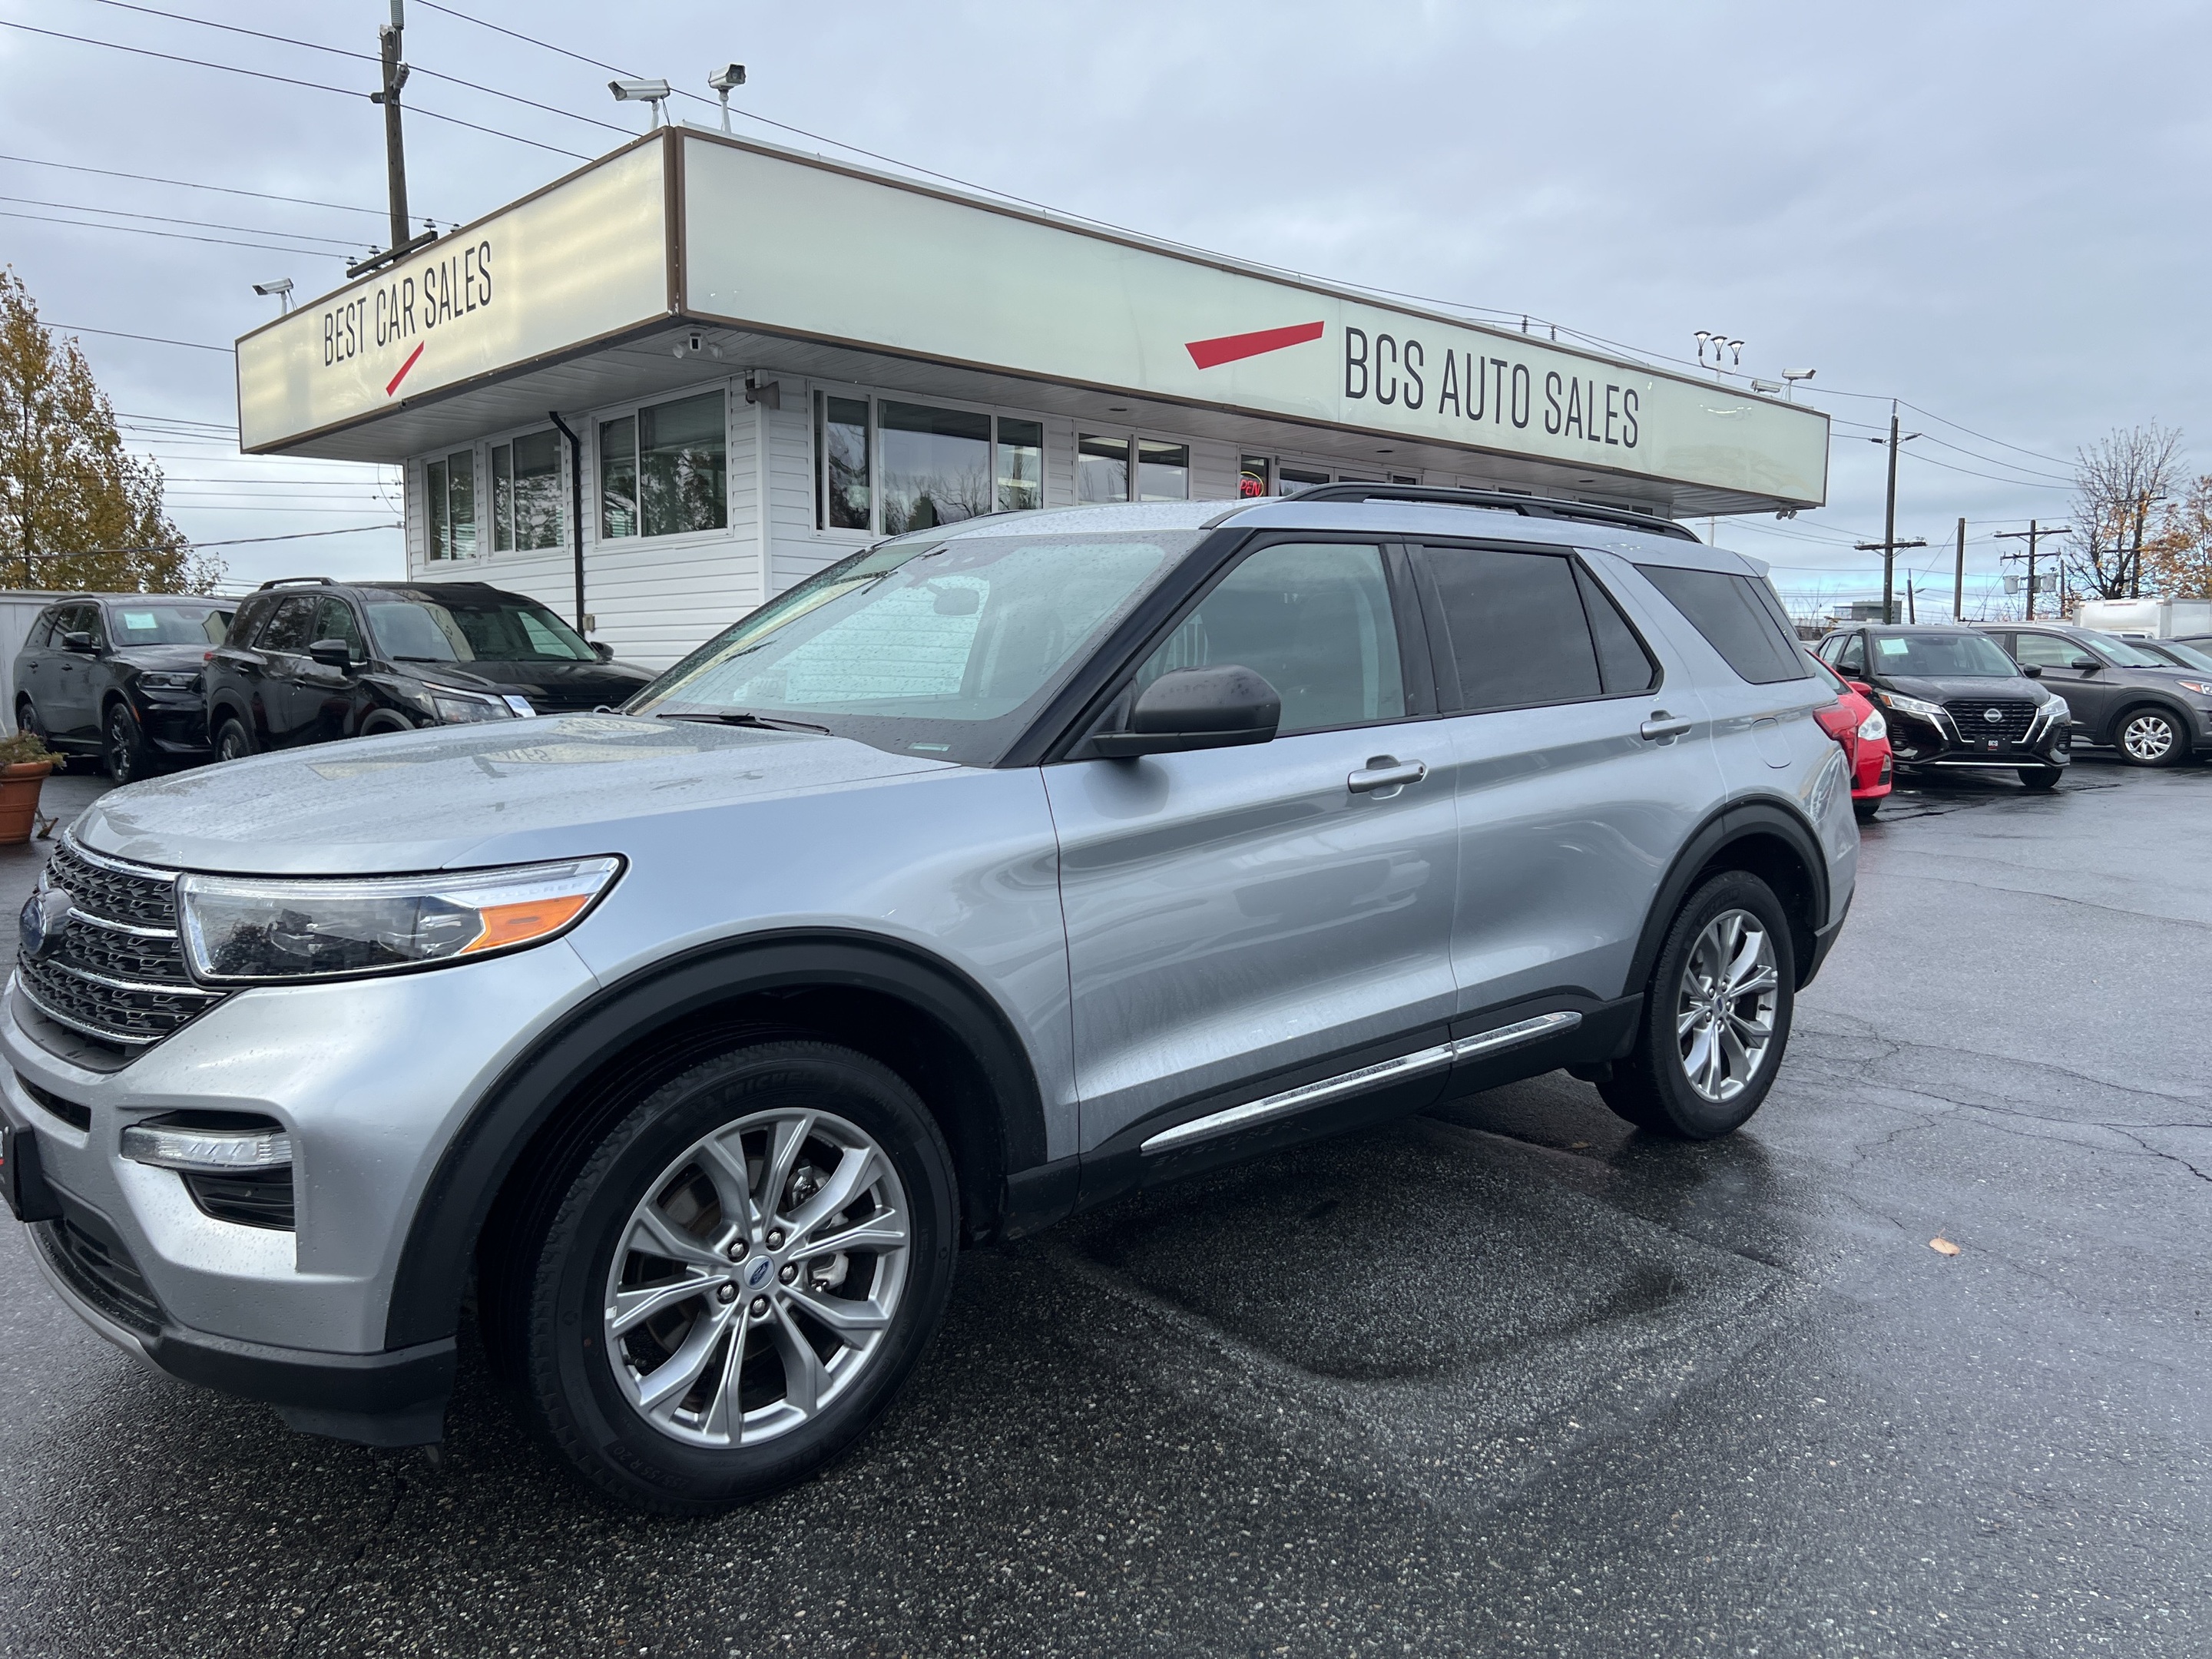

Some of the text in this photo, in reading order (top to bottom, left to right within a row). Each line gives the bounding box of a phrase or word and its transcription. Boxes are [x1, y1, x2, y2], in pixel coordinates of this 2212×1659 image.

[324, 240, 491, 366] BEST CAR SALES
[1345, 326, 1640, 449] BCS AUTO SALES
[1240, 479, 1262, 496] PEN
